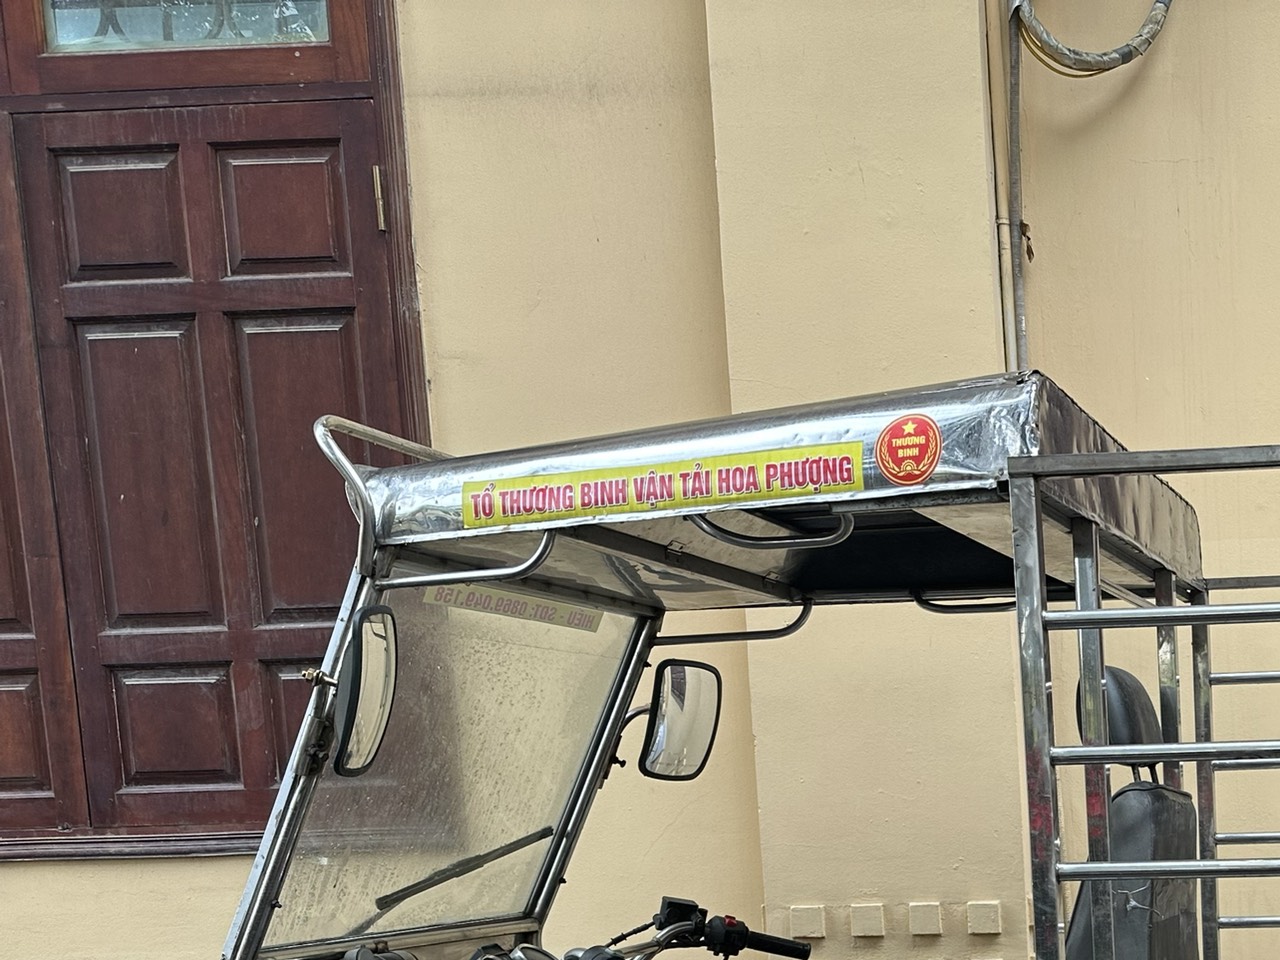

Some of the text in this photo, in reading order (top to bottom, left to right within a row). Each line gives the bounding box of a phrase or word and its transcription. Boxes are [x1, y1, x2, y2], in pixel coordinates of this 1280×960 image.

[892, 435, 926, 448] THƯƠNG
[897, 447, 919, 458] BINH
[470, 455, 854, 520] TỔ THƯƠNG BINH VẬN TẢI HOA PHƯỢNG
